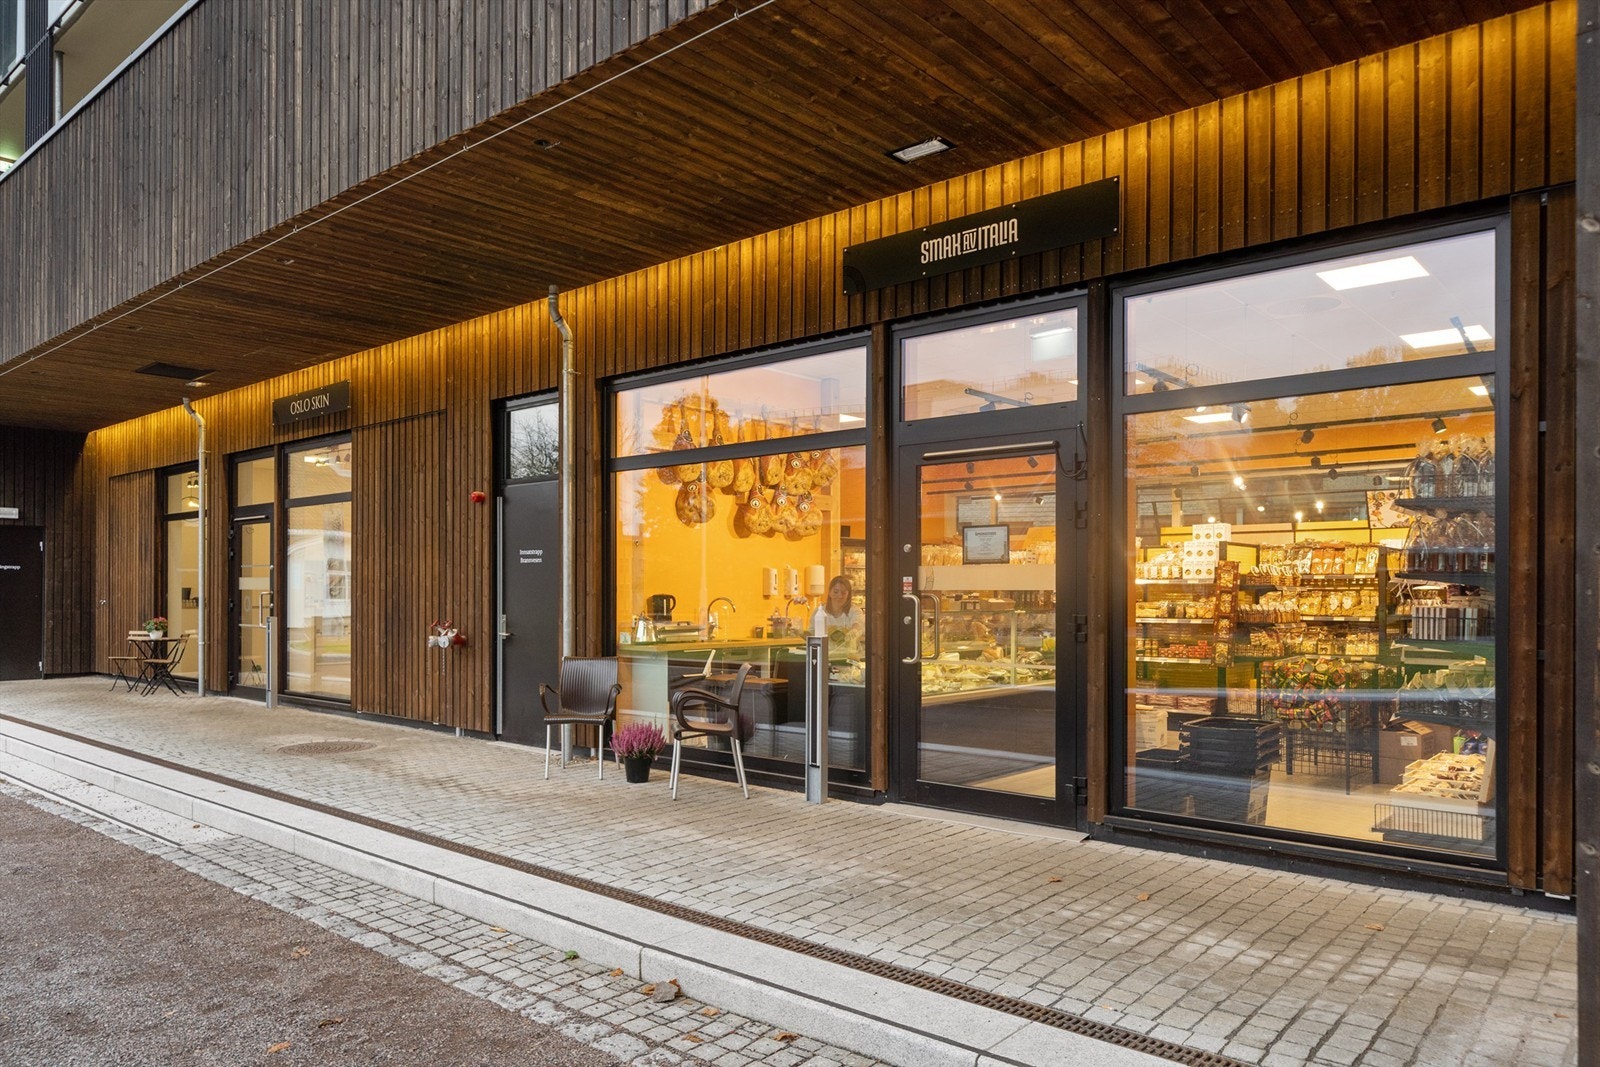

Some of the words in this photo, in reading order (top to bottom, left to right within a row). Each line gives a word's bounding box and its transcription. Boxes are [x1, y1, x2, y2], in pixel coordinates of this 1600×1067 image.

[921, 233, 962, 264] SMAK
[963, 231, 977, 251] AV
[978, 218, 1019, 251] ITALIA
[290, 398, 310, 415] OSLO
[311, 393, 330, 410] SKIN
